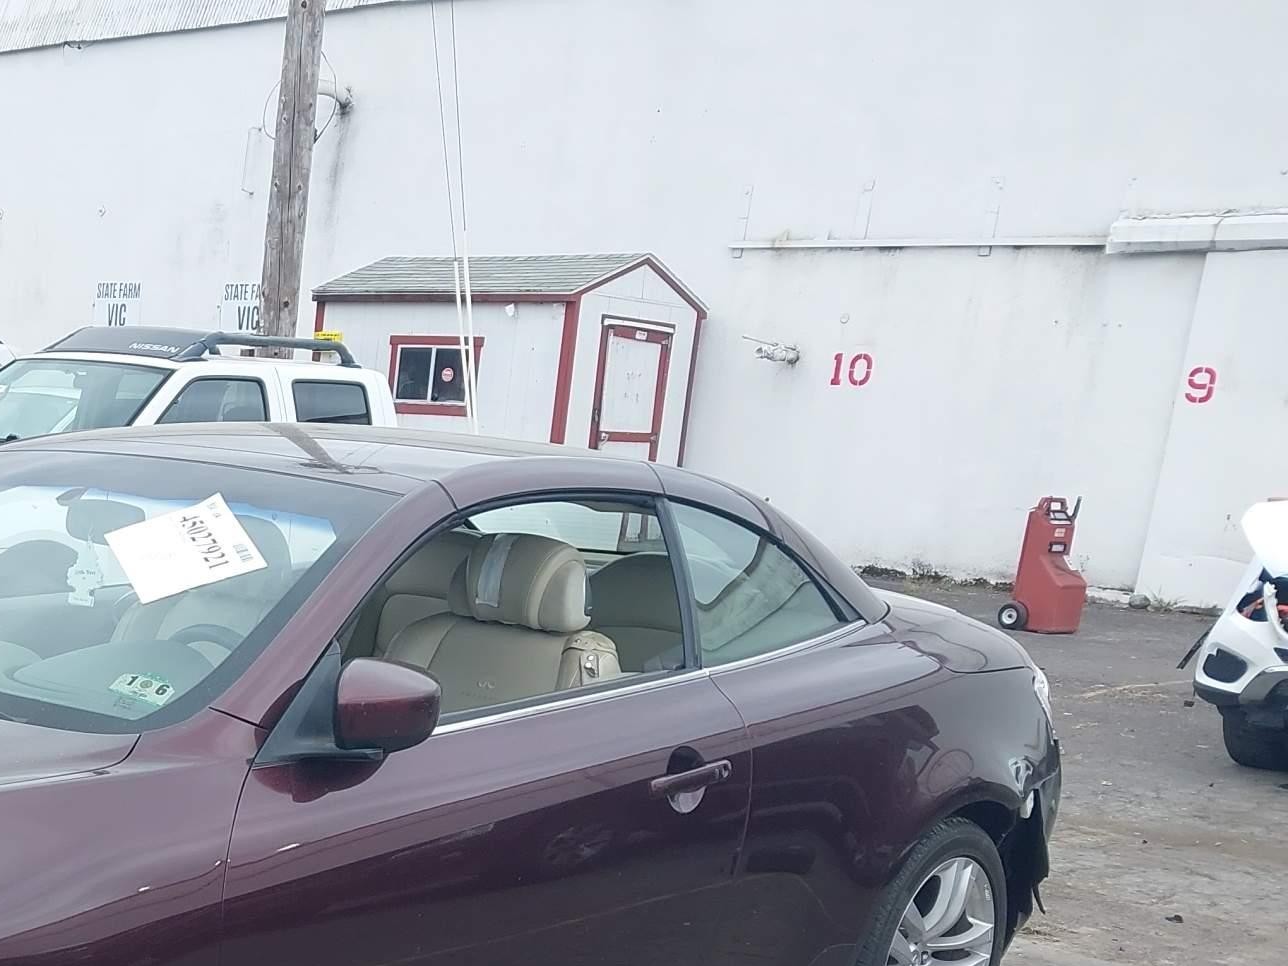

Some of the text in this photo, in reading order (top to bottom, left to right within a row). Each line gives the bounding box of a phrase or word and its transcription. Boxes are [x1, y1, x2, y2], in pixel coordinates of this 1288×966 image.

[97, 282, 142, 299] STATE FARM
[224, 283, 250, 301] STATE
[107, 303, 127, 327] VIC
[237, 305, 260, 331] VIC
[128, 342, 181, 355] NISSAN
[830, 352, 873, 386] 10
[1184, 366, 1217, 404] 9
[179, 514, 230, 569] 45027921
[126, 675, 139, 686] 1
[154, 684, 170, 696] 6
